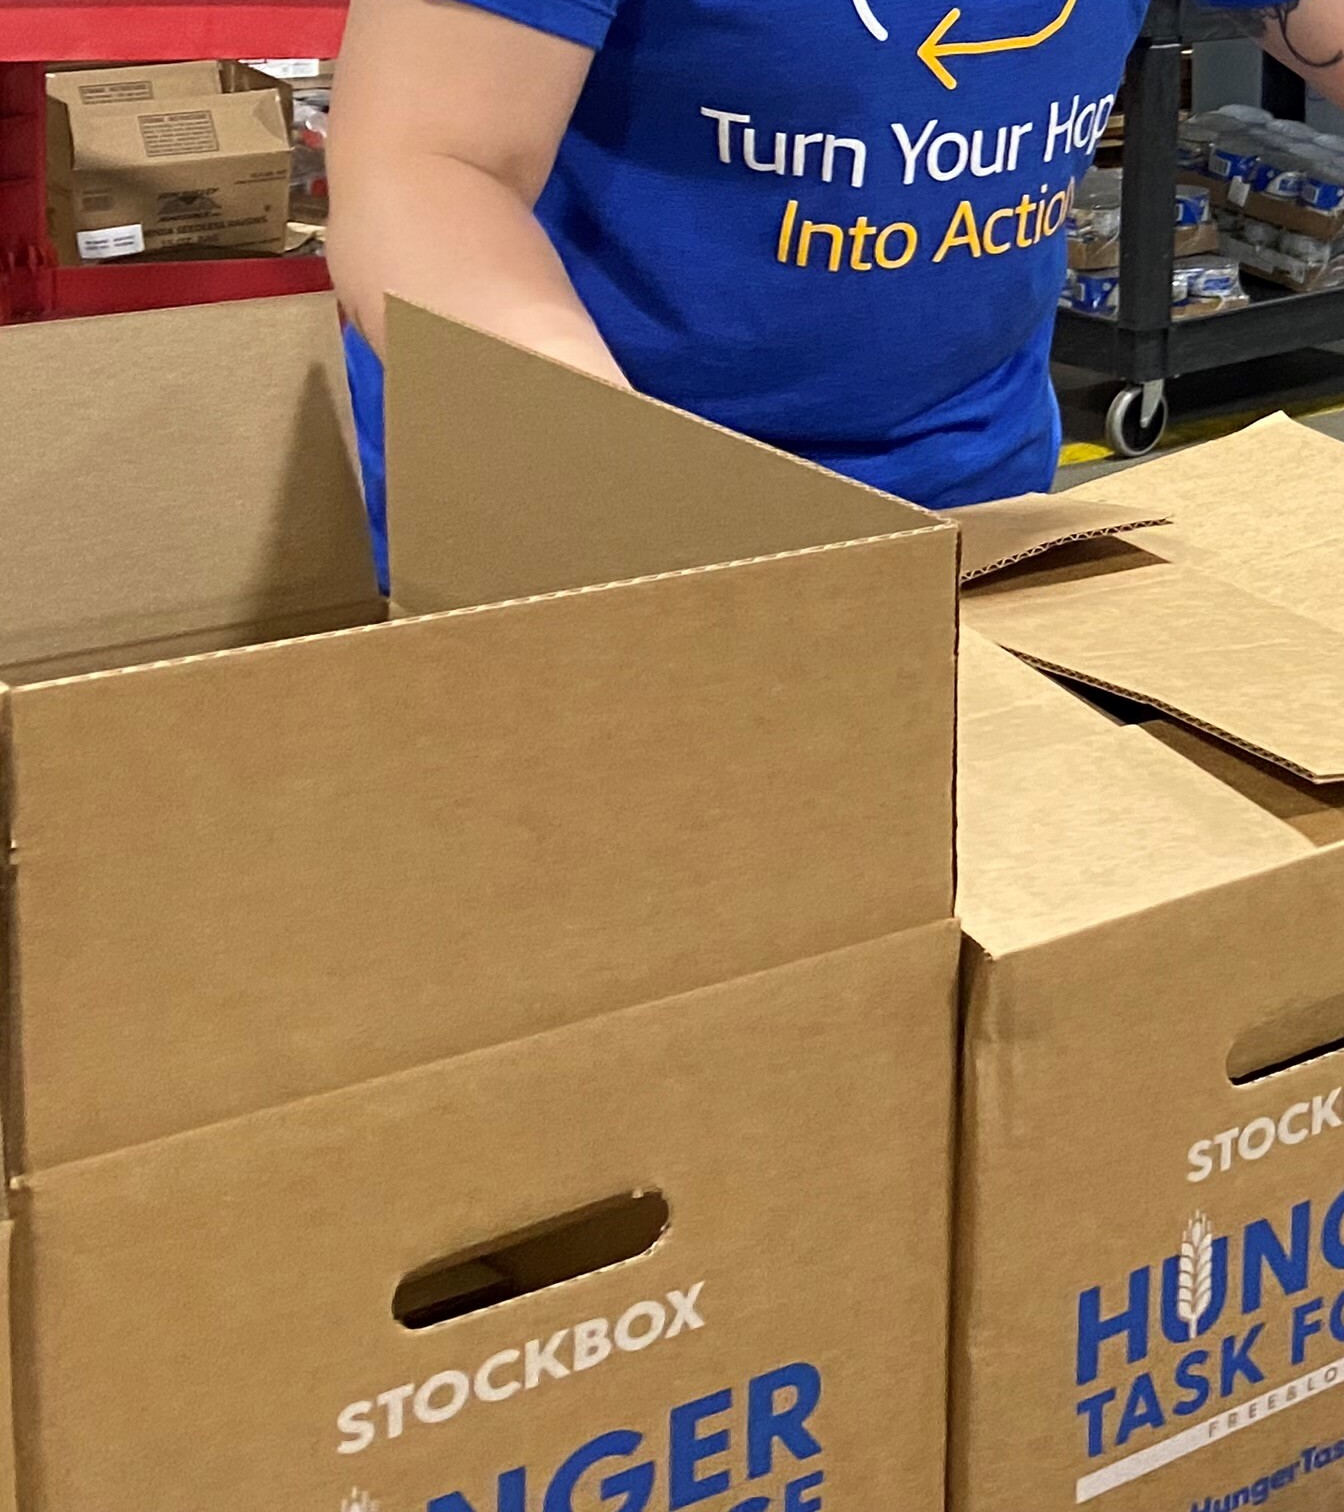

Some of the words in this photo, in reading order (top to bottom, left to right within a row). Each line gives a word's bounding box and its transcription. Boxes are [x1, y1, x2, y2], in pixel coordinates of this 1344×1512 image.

[700, 106, 866, 188] Turn
[891, 120, 1032, 185] Your
[1043, 92, 1115, 163] Hop
[776, 200, 919, 272] Into
[336, 1280, 707, 1455] STOCKBOX
[1077, 1322, 1265, 1459] TASK
